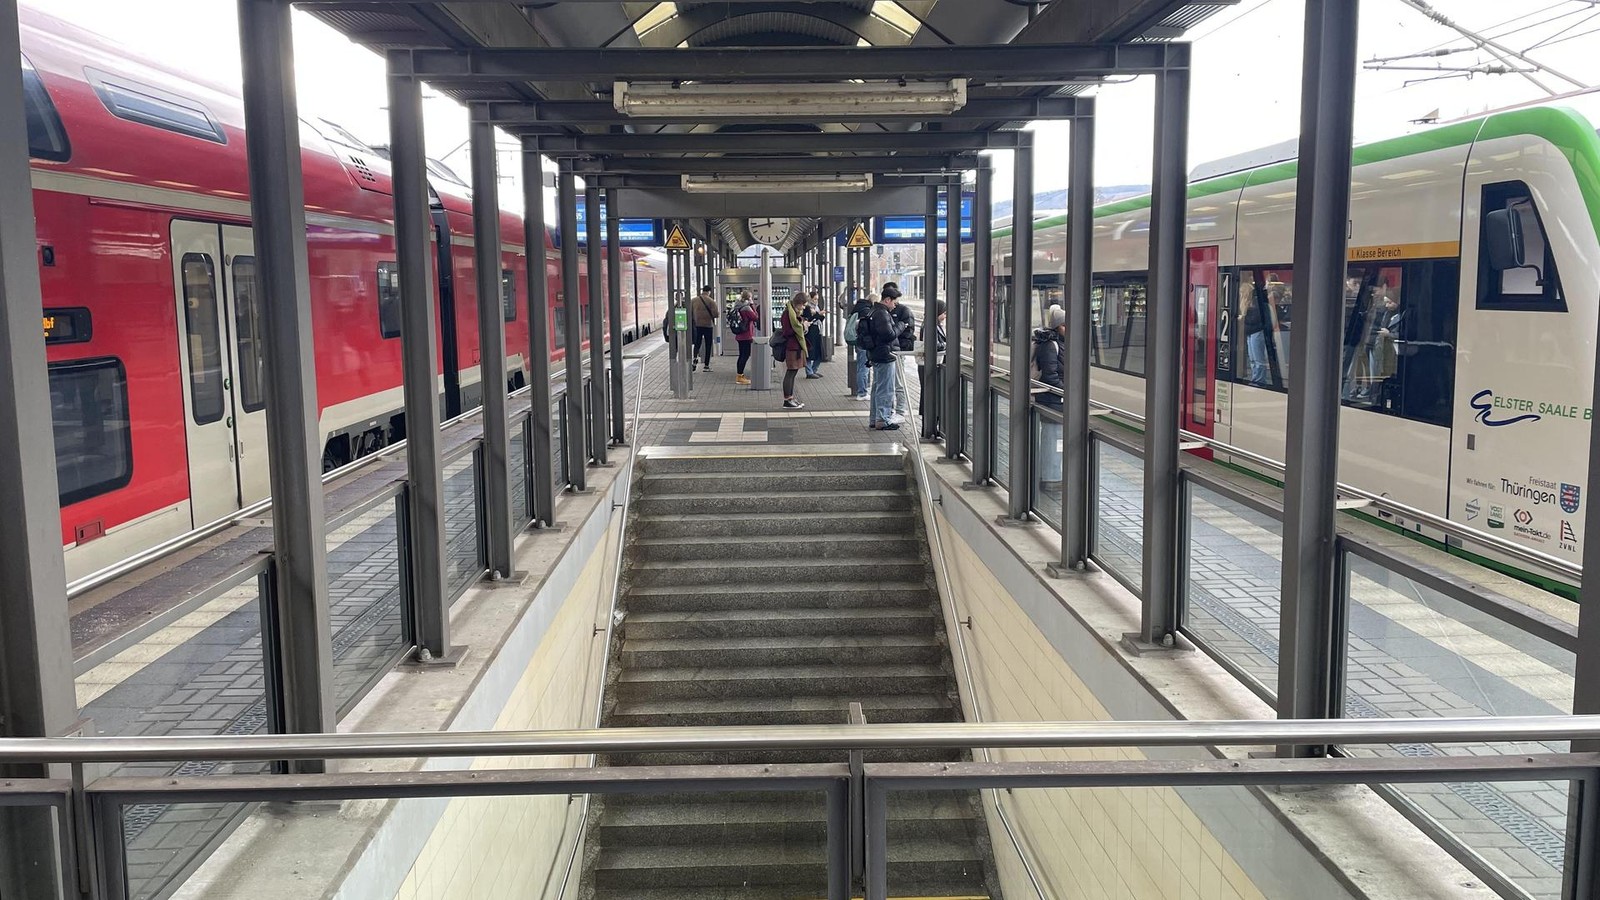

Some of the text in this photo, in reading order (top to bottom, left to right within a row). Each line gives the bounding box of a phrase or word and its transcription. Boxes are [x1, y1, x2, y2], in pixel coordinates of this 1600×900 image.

[1356, 249, 1376, 259] Klasse
[1377, 247, 1402, 258] Bereich
[1222, 274, 1229, 308] 1
[1220, 310, 1229, 342] 2
[1493, 396, 1534, 412] ELSTER
[1538, 402, 1578, 418] SAALE
[1501, 478, 1556, 505] Thüringen
[1529, 476, 1557, 490] Freistaat
